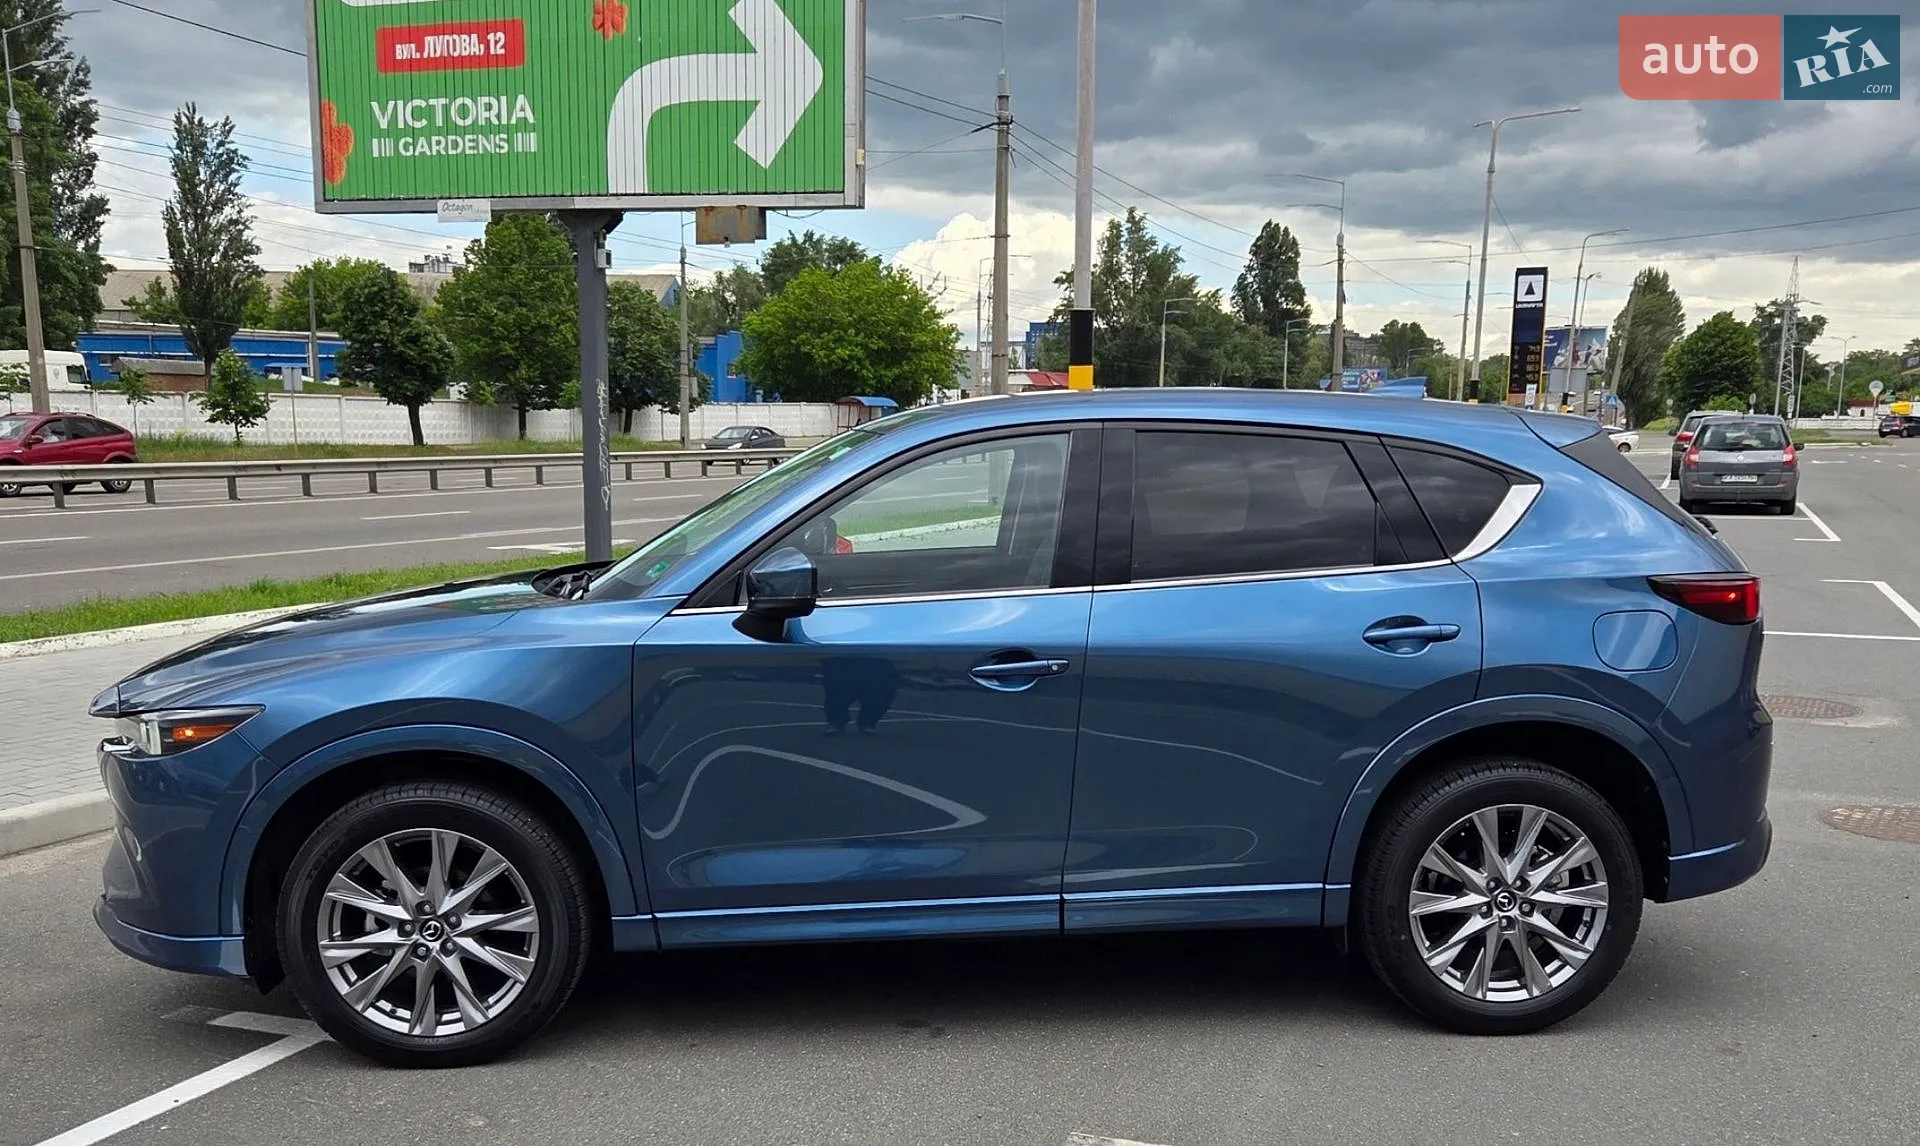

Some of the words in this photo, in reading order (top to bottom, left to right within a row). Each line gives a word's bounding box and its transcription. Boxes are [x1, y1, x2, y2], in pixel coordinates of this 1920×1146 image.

[423, 33, 485, 59] ЛУГОВА,
[487, 31, 506, 55] 12
[370, 93, 536, 129] VICTORIA
[398, 133, 509, 157] GARDENS
